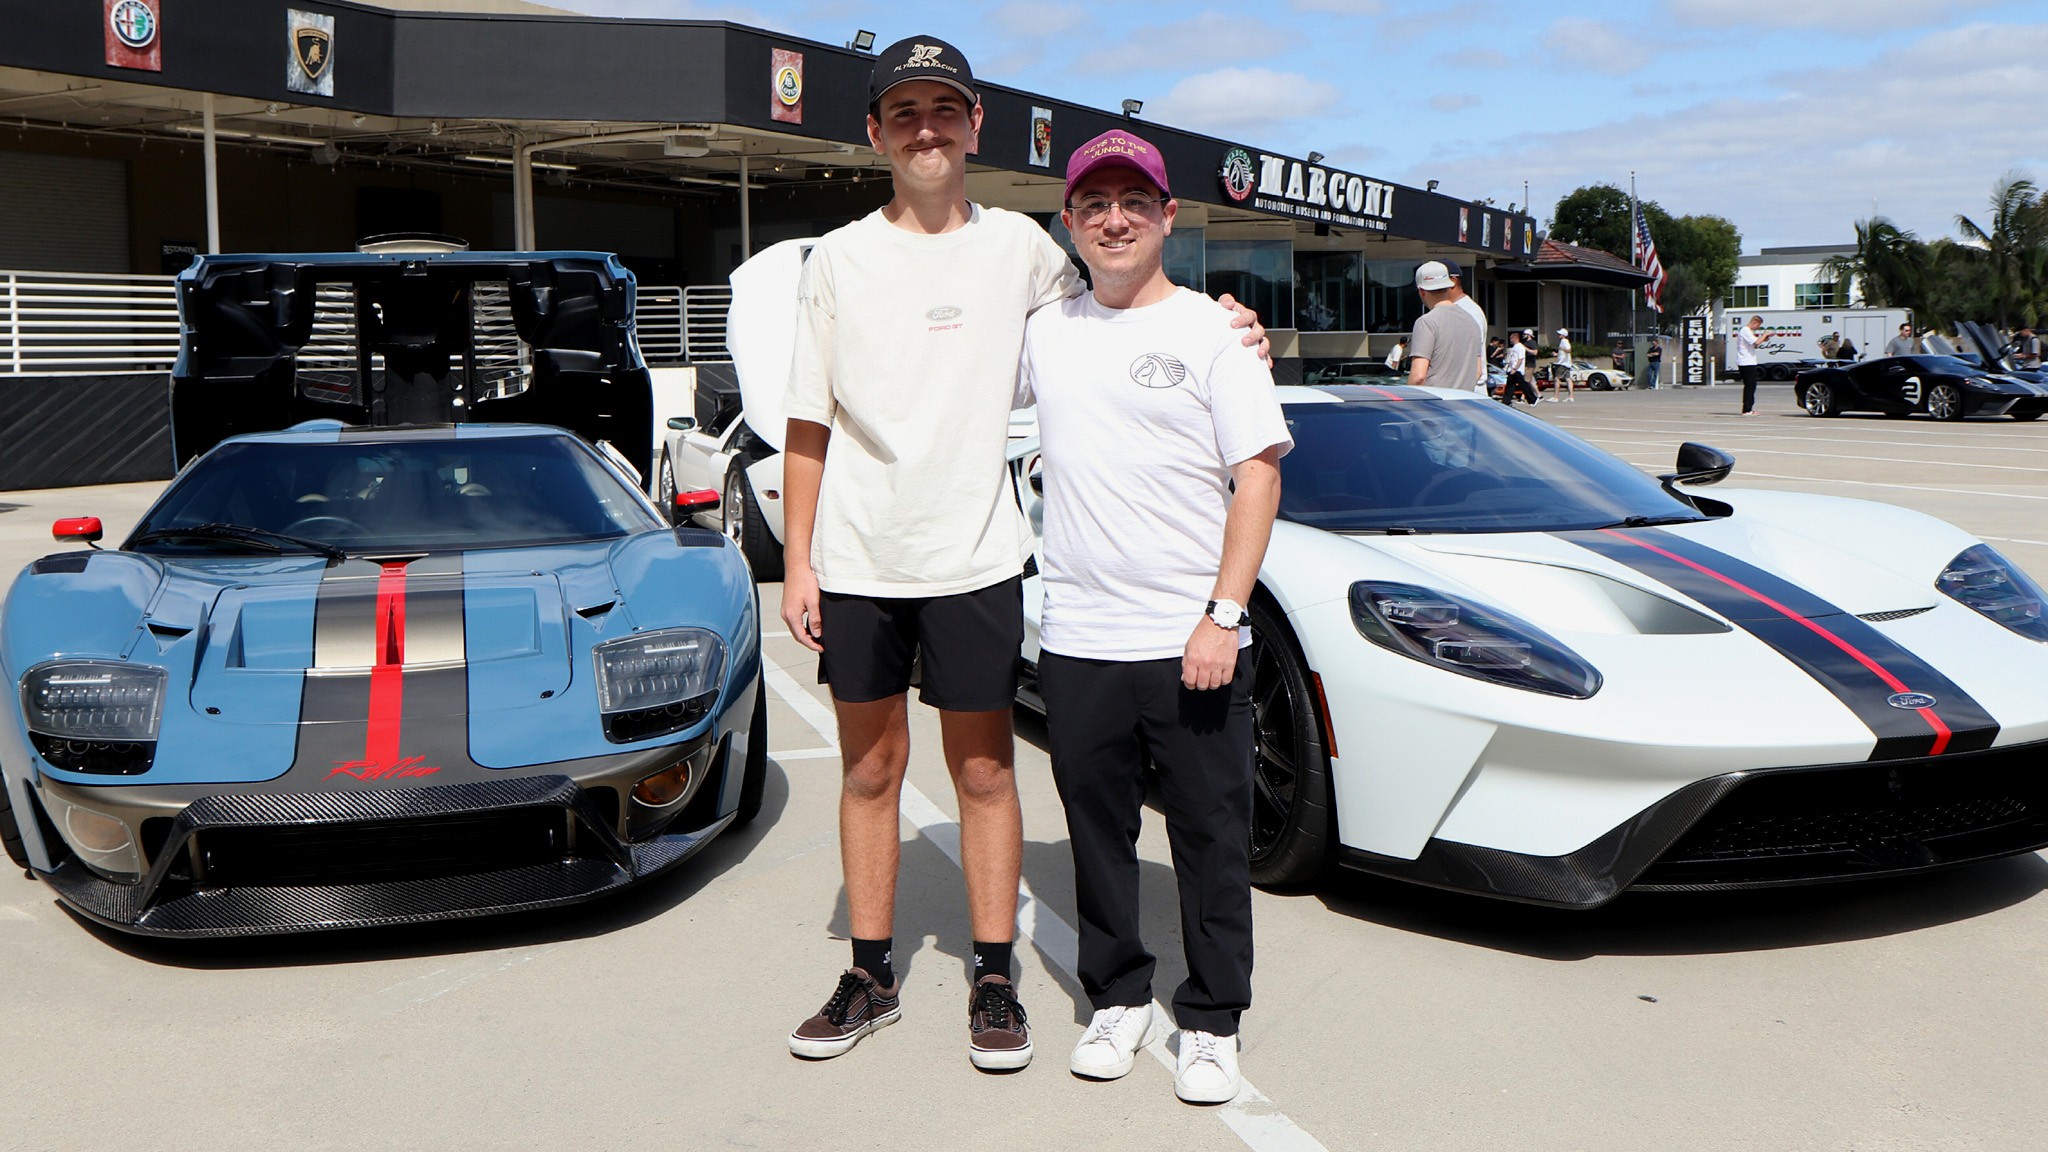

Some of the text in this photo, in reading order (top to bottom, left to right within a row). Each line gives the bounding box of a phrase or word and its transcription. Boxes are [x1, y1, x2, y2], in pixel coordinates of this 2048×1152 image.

[893, 62, 958, 74] FLYING RACING
[1083, 137, 1148, 156] KEYS TO THE
[1091, 145, 1136, 159] JUNGLE
[1257, 154, 1394, 218] MARCONI
[1254, 197, 1388, 231] AUTOMOTIVE MUSEUM AND FOUNDATION FOR KIDS
[931, 307, 957, 319] Ford
[1688, 319, 1703, 383] ENTRANCE
